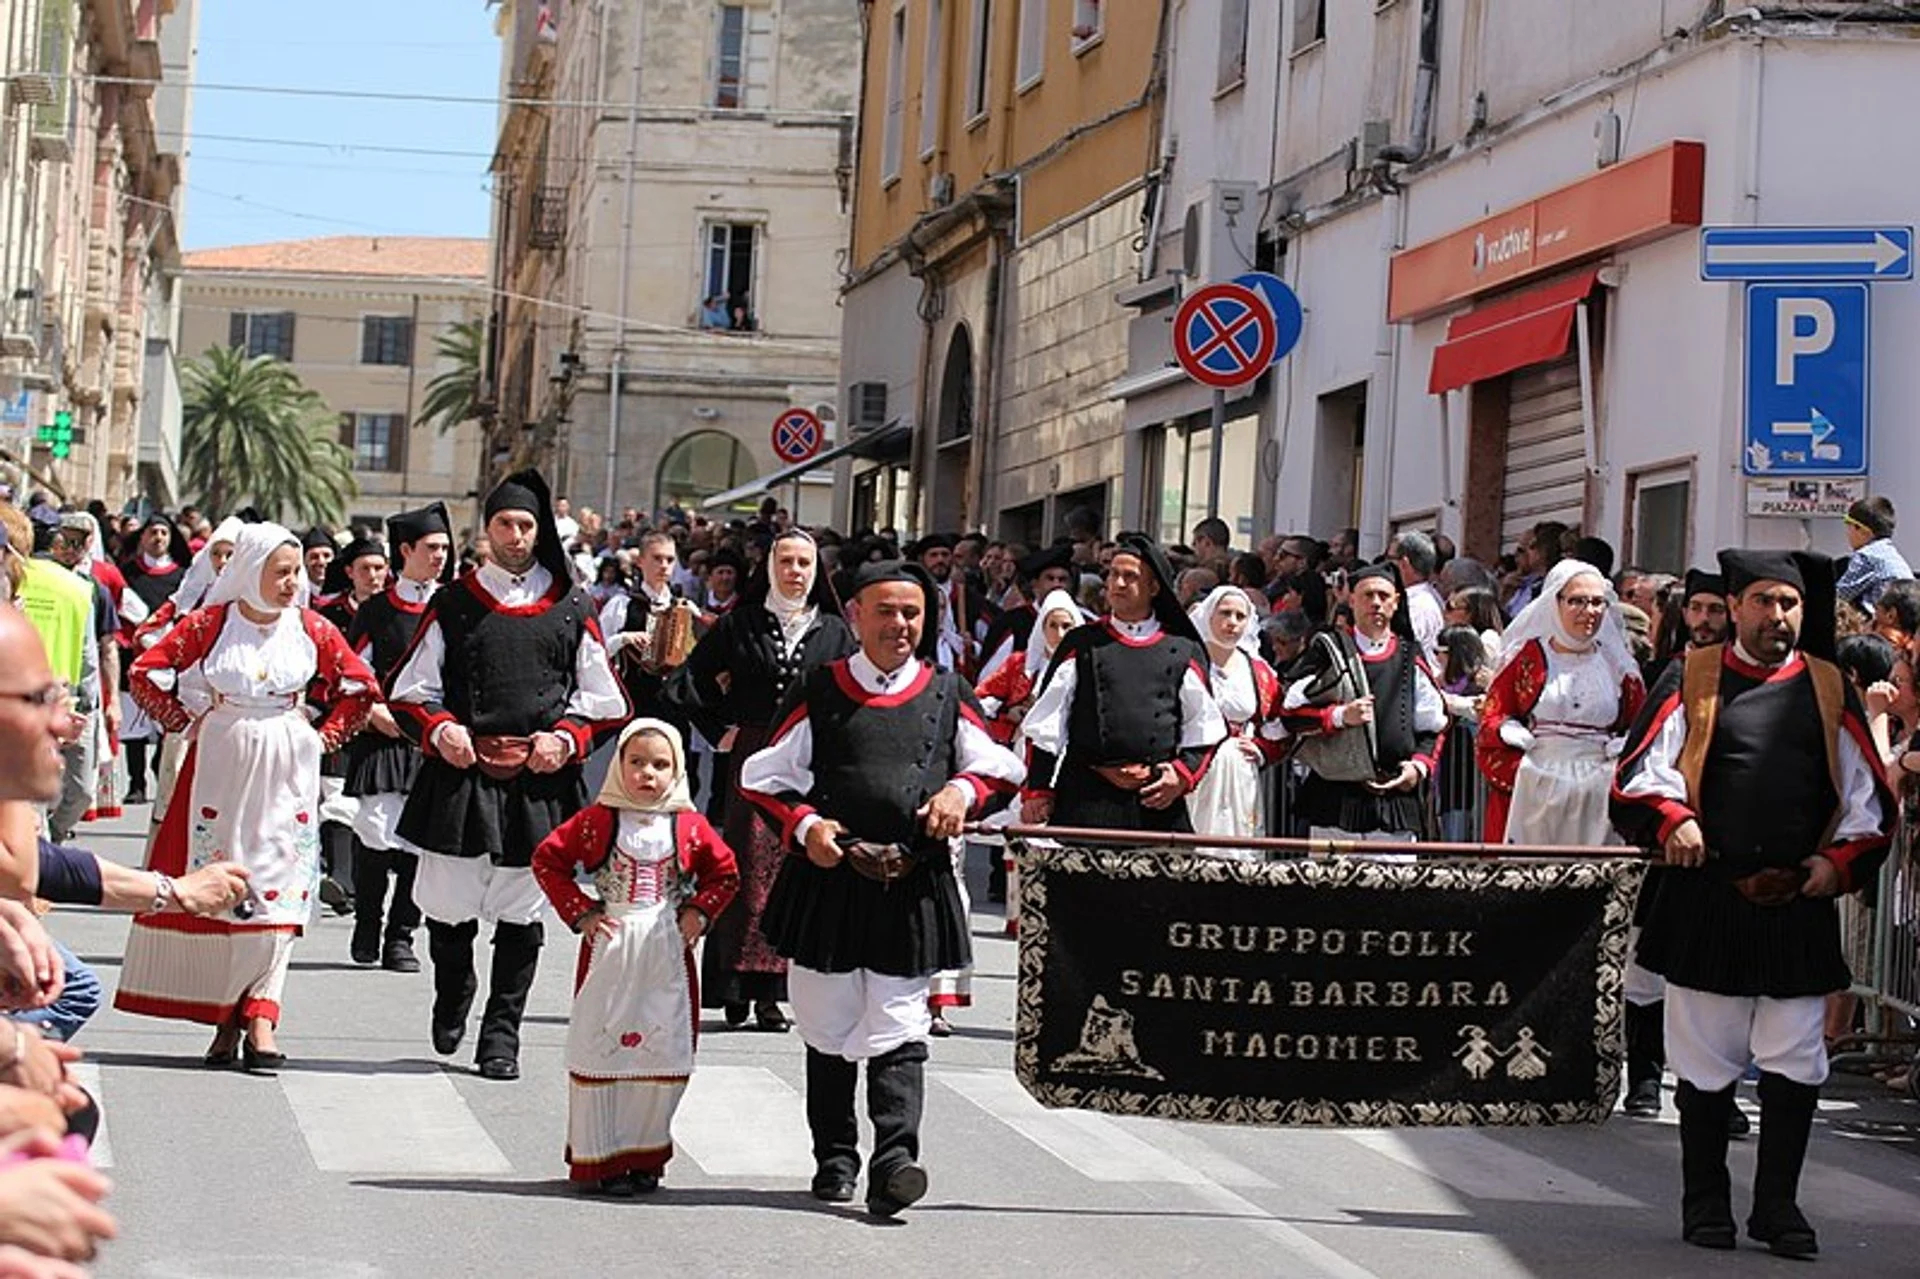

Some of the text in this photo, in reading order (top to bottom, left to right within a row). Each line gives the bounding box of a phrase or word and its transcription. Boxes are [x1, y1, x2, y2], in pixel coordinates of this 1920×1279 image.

[1776, 297, 1835, 385] P
[1762, 501, 1807, 512] PIAZZA
[1167, 921, 1478, 956] GRUPPO FOLK
[1120, 969, 1512, 1007] SANTA BARBARA
[1202, 1029, 1423, 1062] MACOMER
